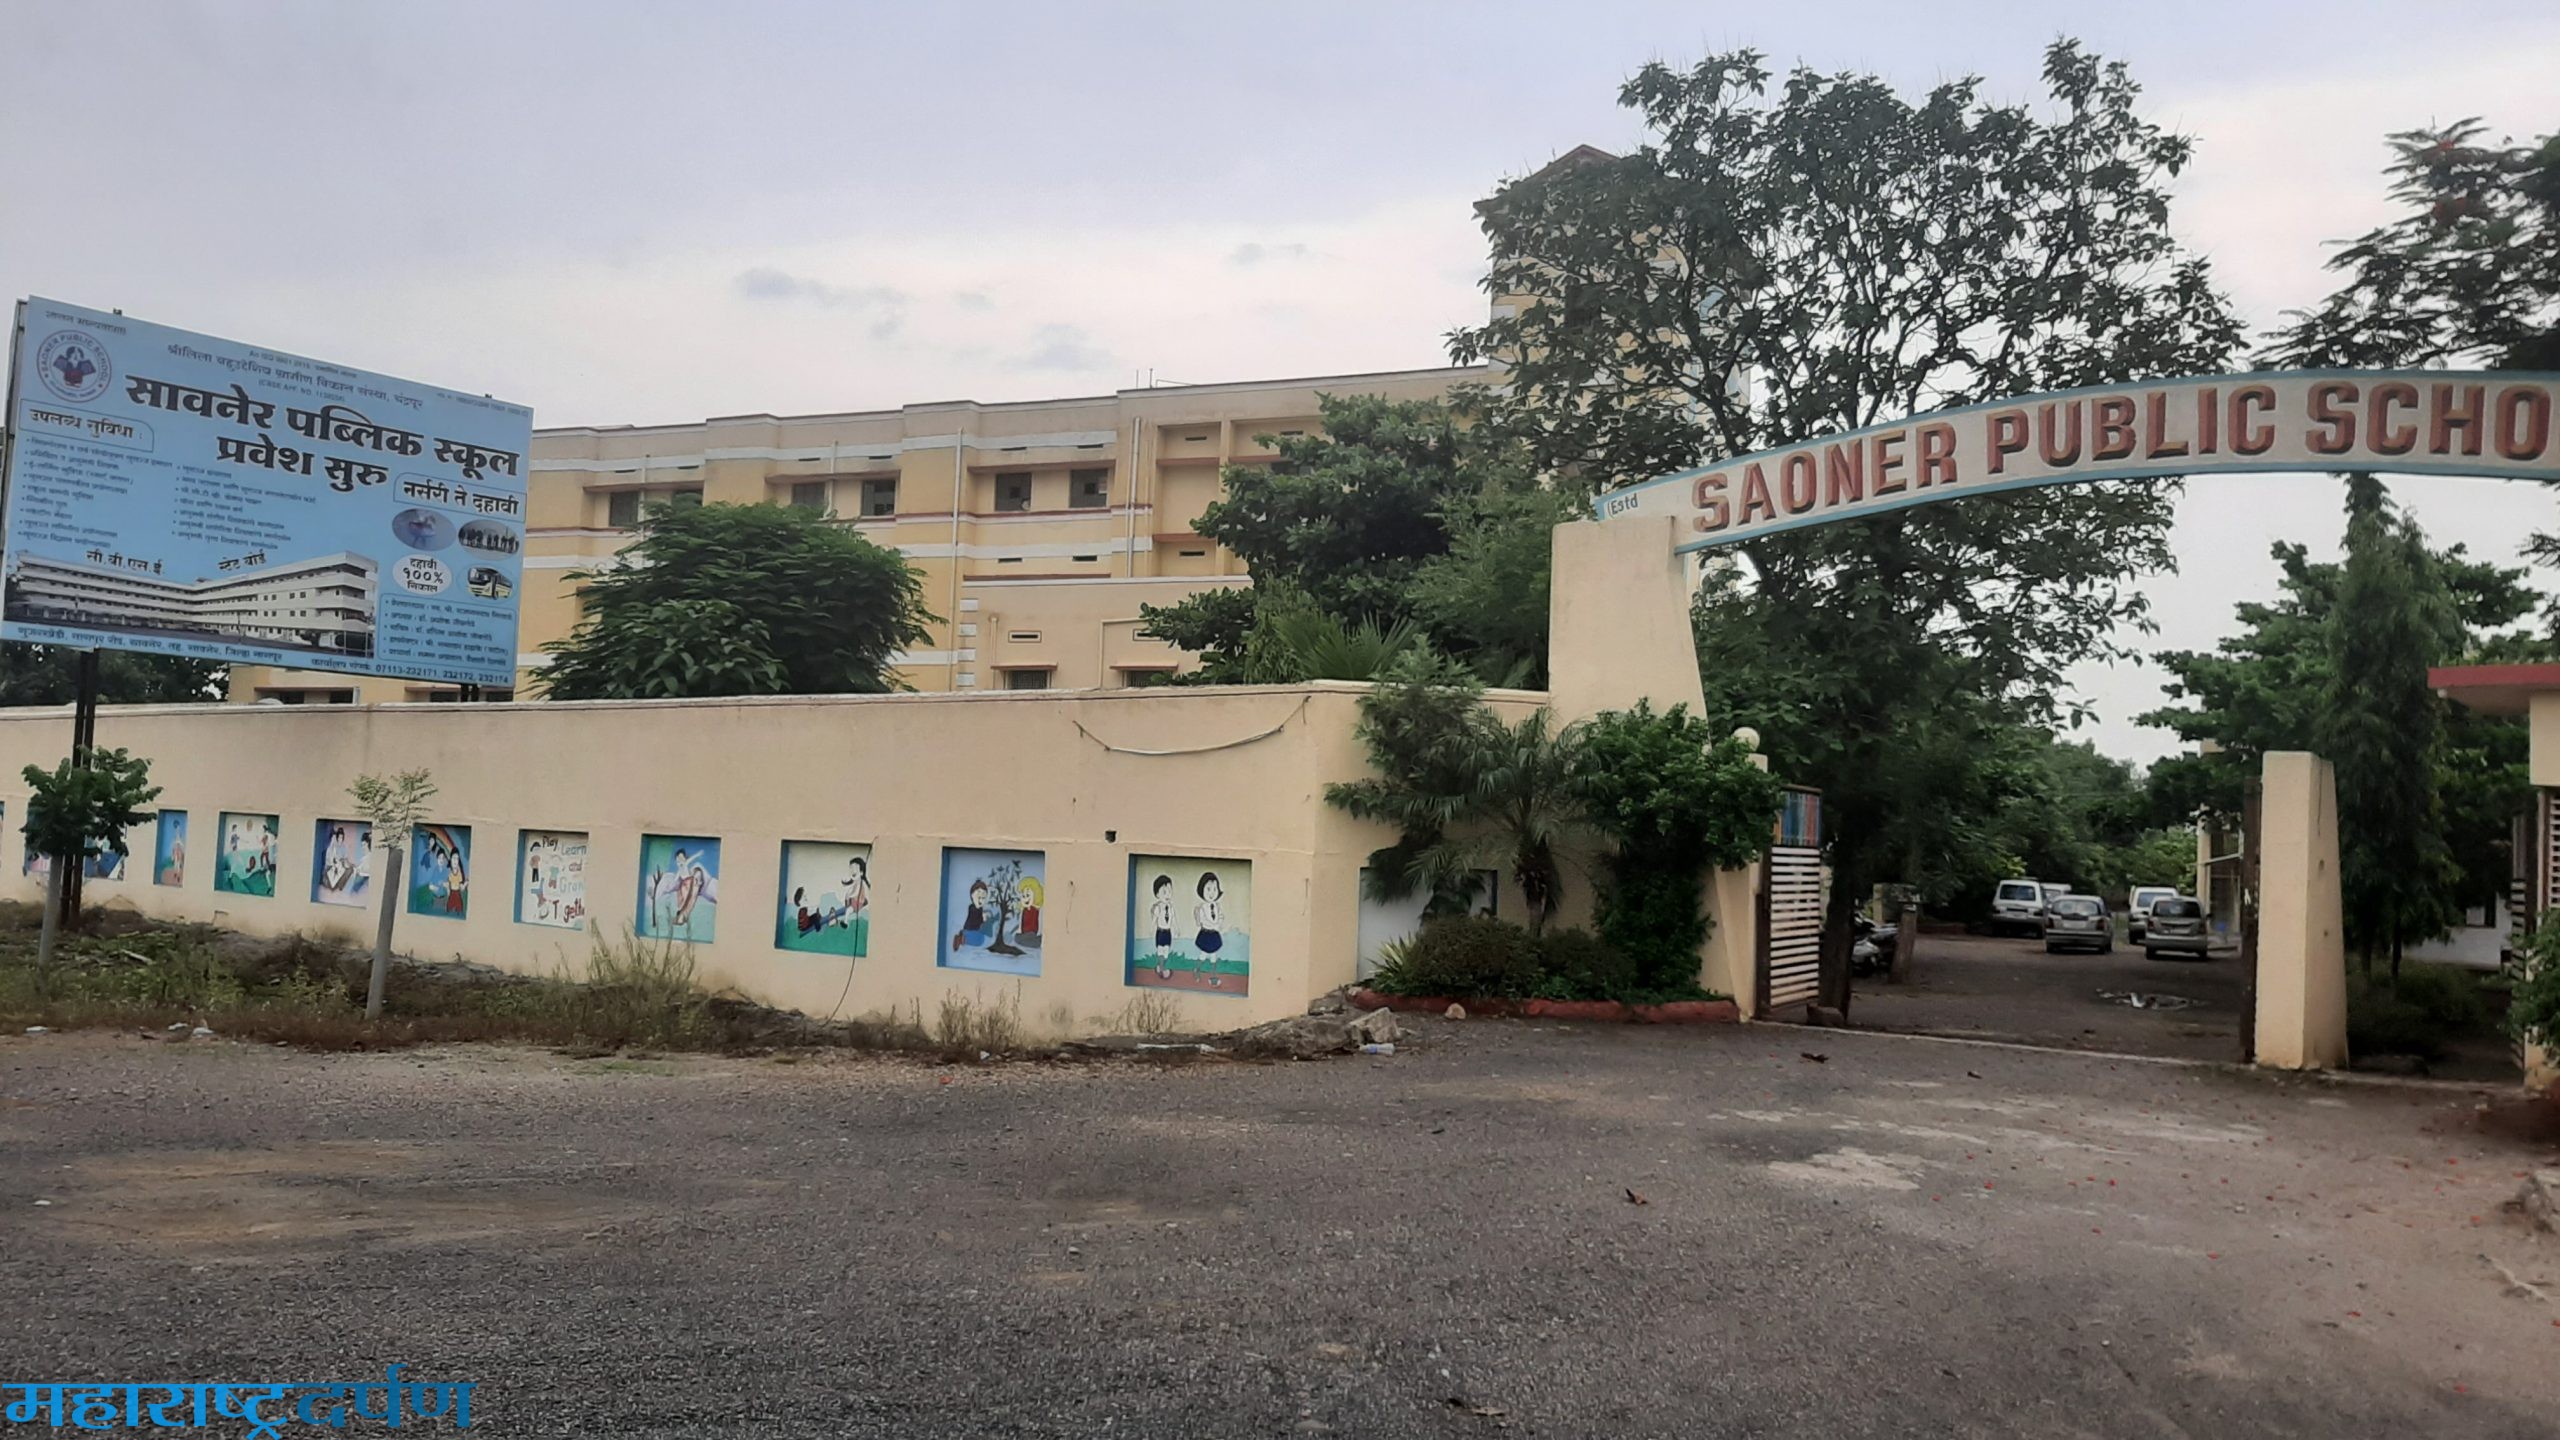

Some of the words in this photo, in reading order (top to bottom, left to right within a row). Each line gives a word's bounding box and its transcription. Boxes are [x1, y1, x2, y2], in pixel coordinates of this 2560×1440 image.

[125, 374, 275, 430] सावनेर
[286, 403, 425, 458] पब्लिक
[433, 437, 520, 481] स्कूल
[216, 433, 315, 477] प्रवेश
[324, 455, 389, 493] सुरु
[1690, 422, 1958, 534] SAONER
[1985, 384, 2277, 475] PUBLIC
[403, 479, 450, 504] नर्सरी
[454, 485, 468, 507] ते
[473, 493, 520, 516] दहावी
[409, 557, 438, 571] दहावी
